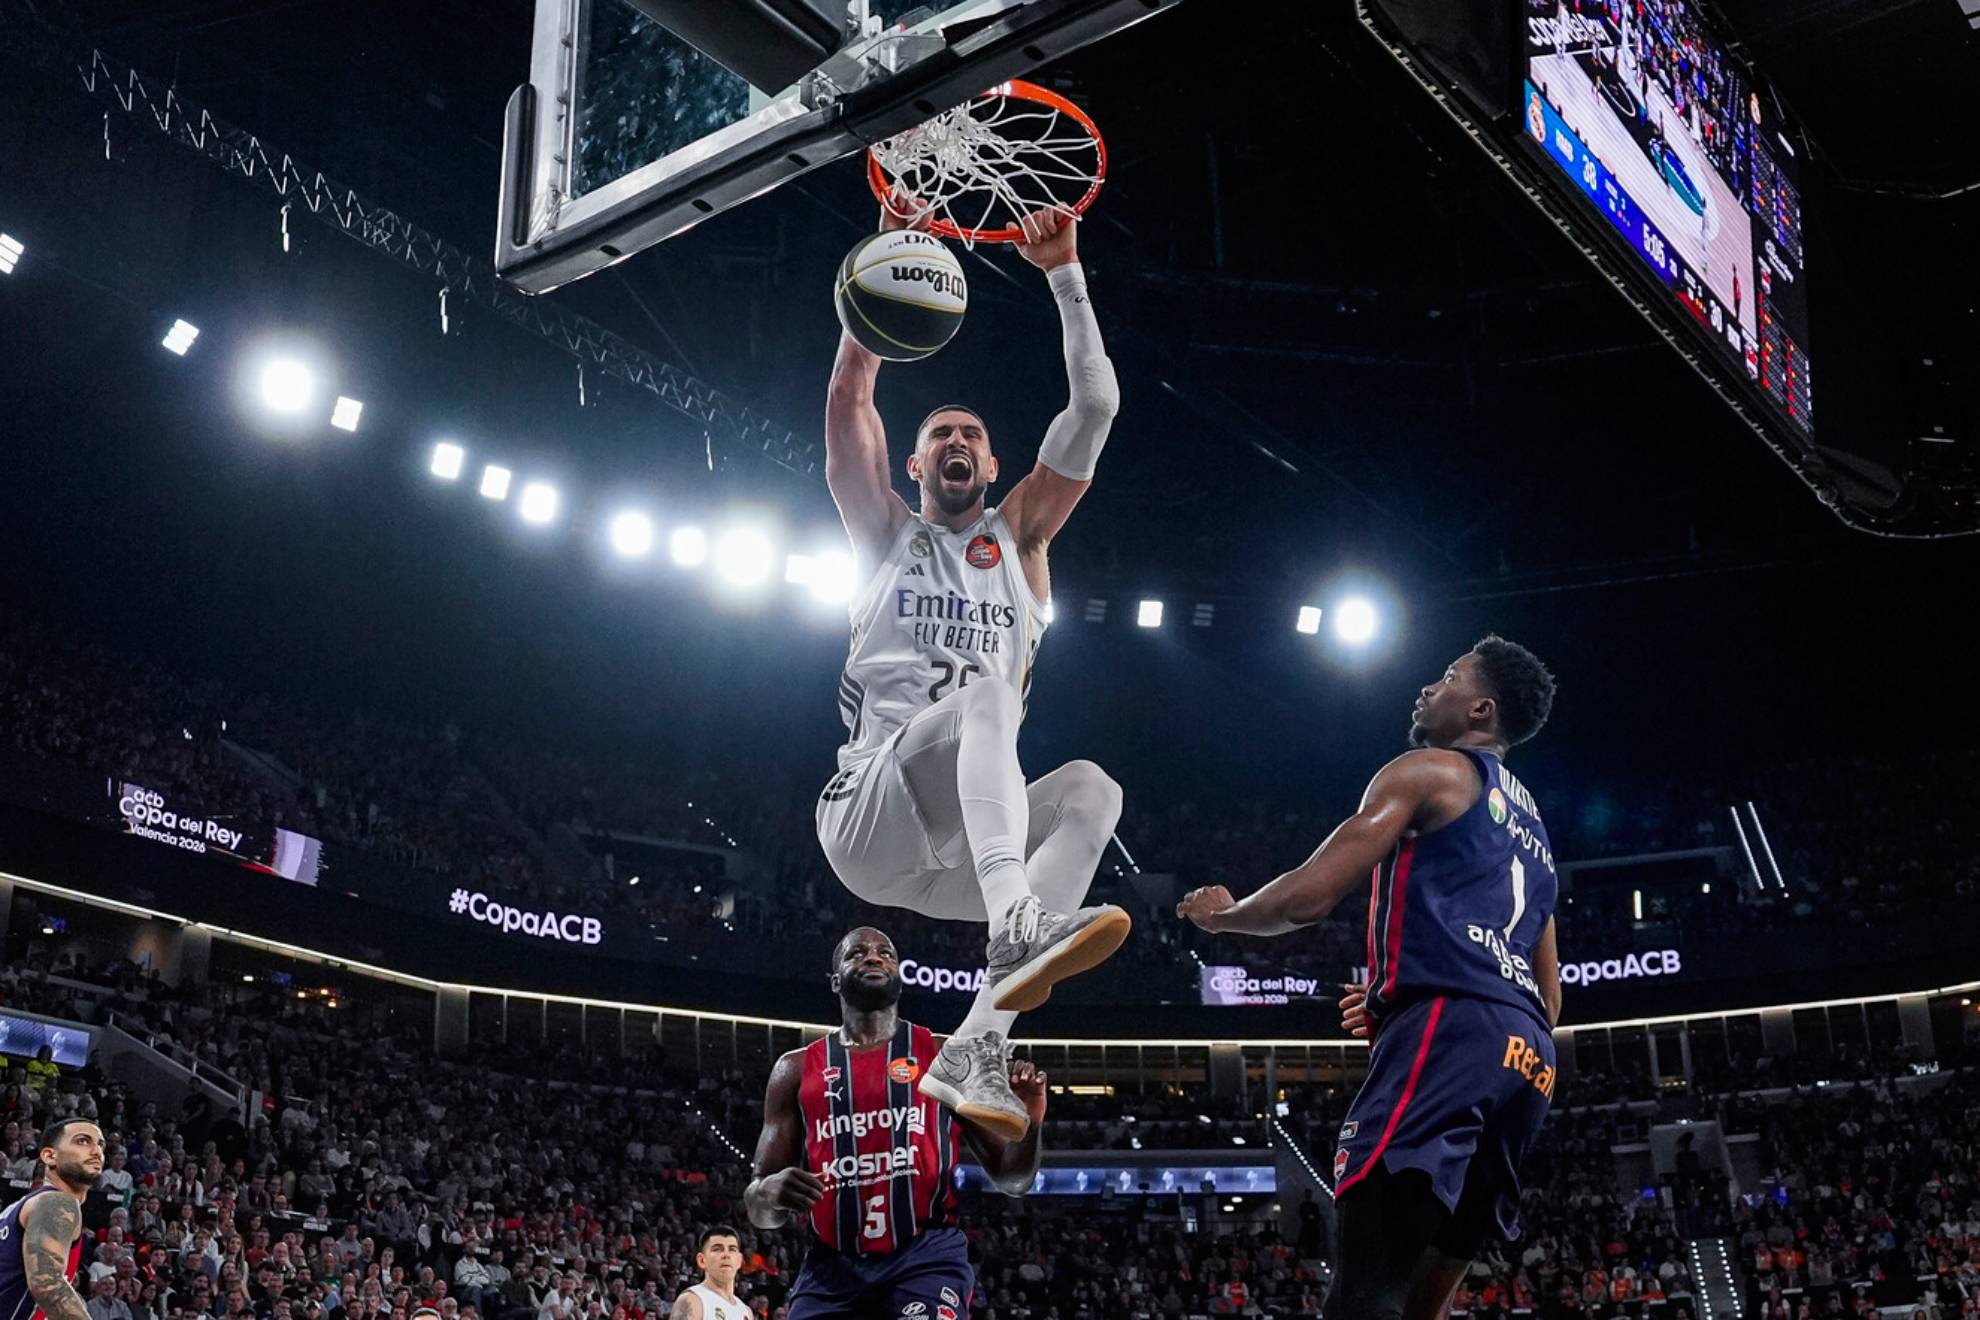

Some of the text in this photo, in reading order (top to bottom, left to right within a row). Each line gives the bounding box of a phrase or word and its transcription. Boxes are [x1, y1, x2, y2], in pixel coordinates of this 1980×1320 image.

[891, 266, 964, 301] Wilson
[898, 589, 1015, 628] Emirates
[915, 623, 999, 654] FLY BETTER
[133, 789, 165, 809] acb
[119, 796, 243, 850] Copa del Rey
[128, 822, 206, 854] Valencia 2026
[448, 887, 602, 945] #CopaACB
[1503, 854, 1525, 942] 1
[1210, 976, 1317, 995] Copa del Rey
[816, 1103, 926, 1143] kingroyal
[864, 1194, 887, 1239] 5
